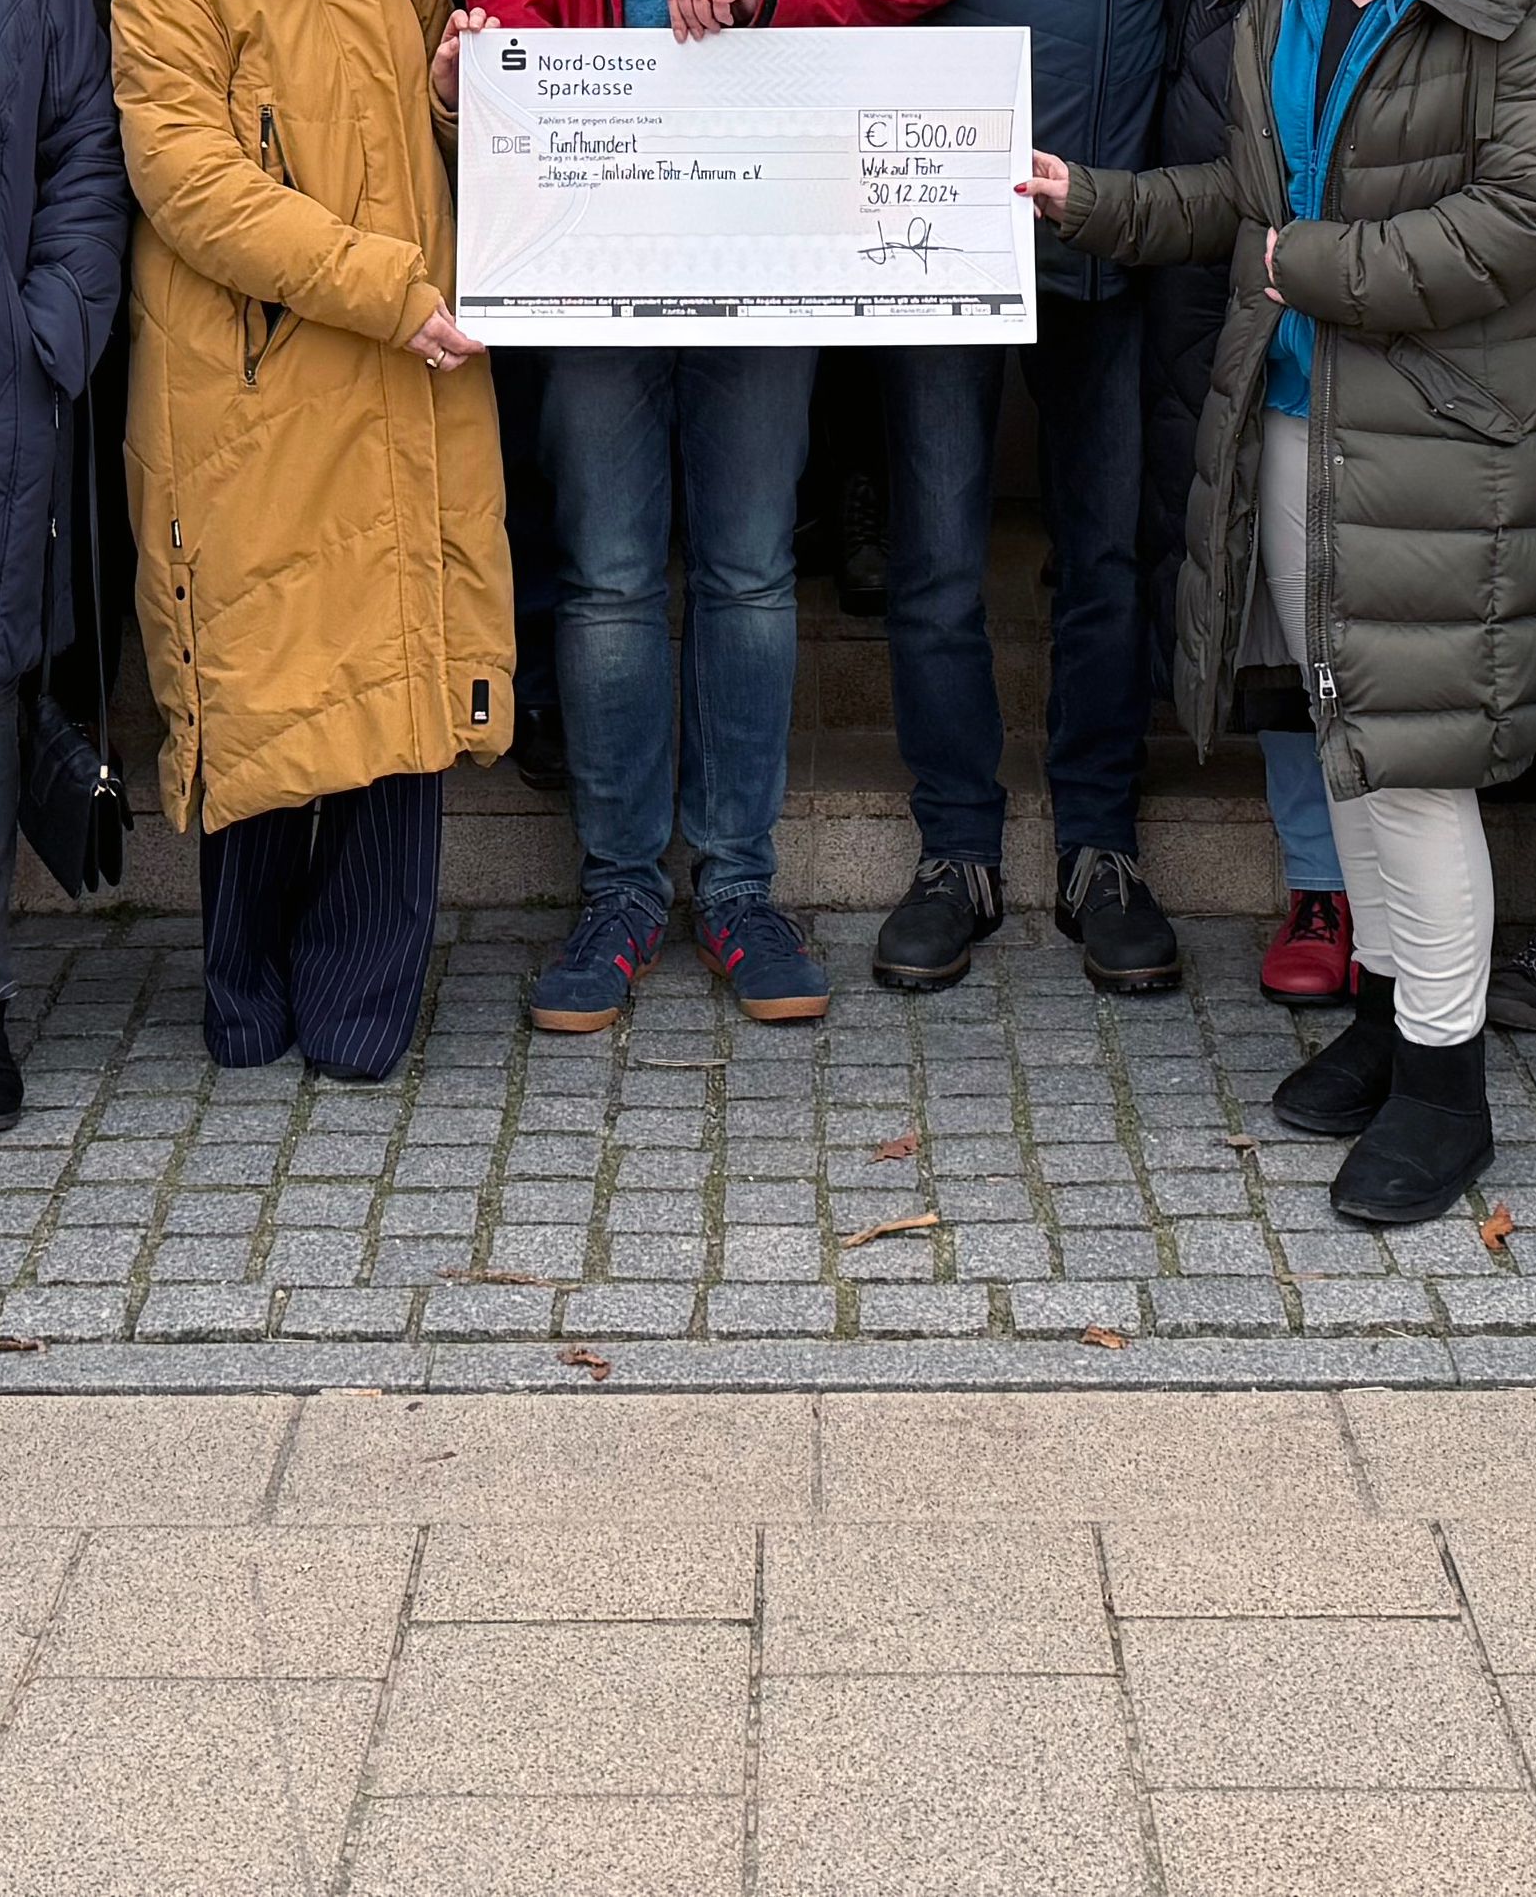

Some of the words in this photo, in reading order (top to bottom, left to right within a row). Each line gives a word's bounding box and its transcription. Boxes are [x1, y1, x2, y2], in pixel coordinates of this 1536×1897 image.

[538, 54, 657, 72] Nord-Ostsee
[537, 78, 634, 100] Sparkasse
[492, 135, 531, 154] DE
[864, 121, 888, 148] €
[905, 122, 977, 149] 500,00
[861, 157, 889, 179] Wyk
[890, 157, 911, 176] auf
[868, 182, 960, 205] 30.12.2024
